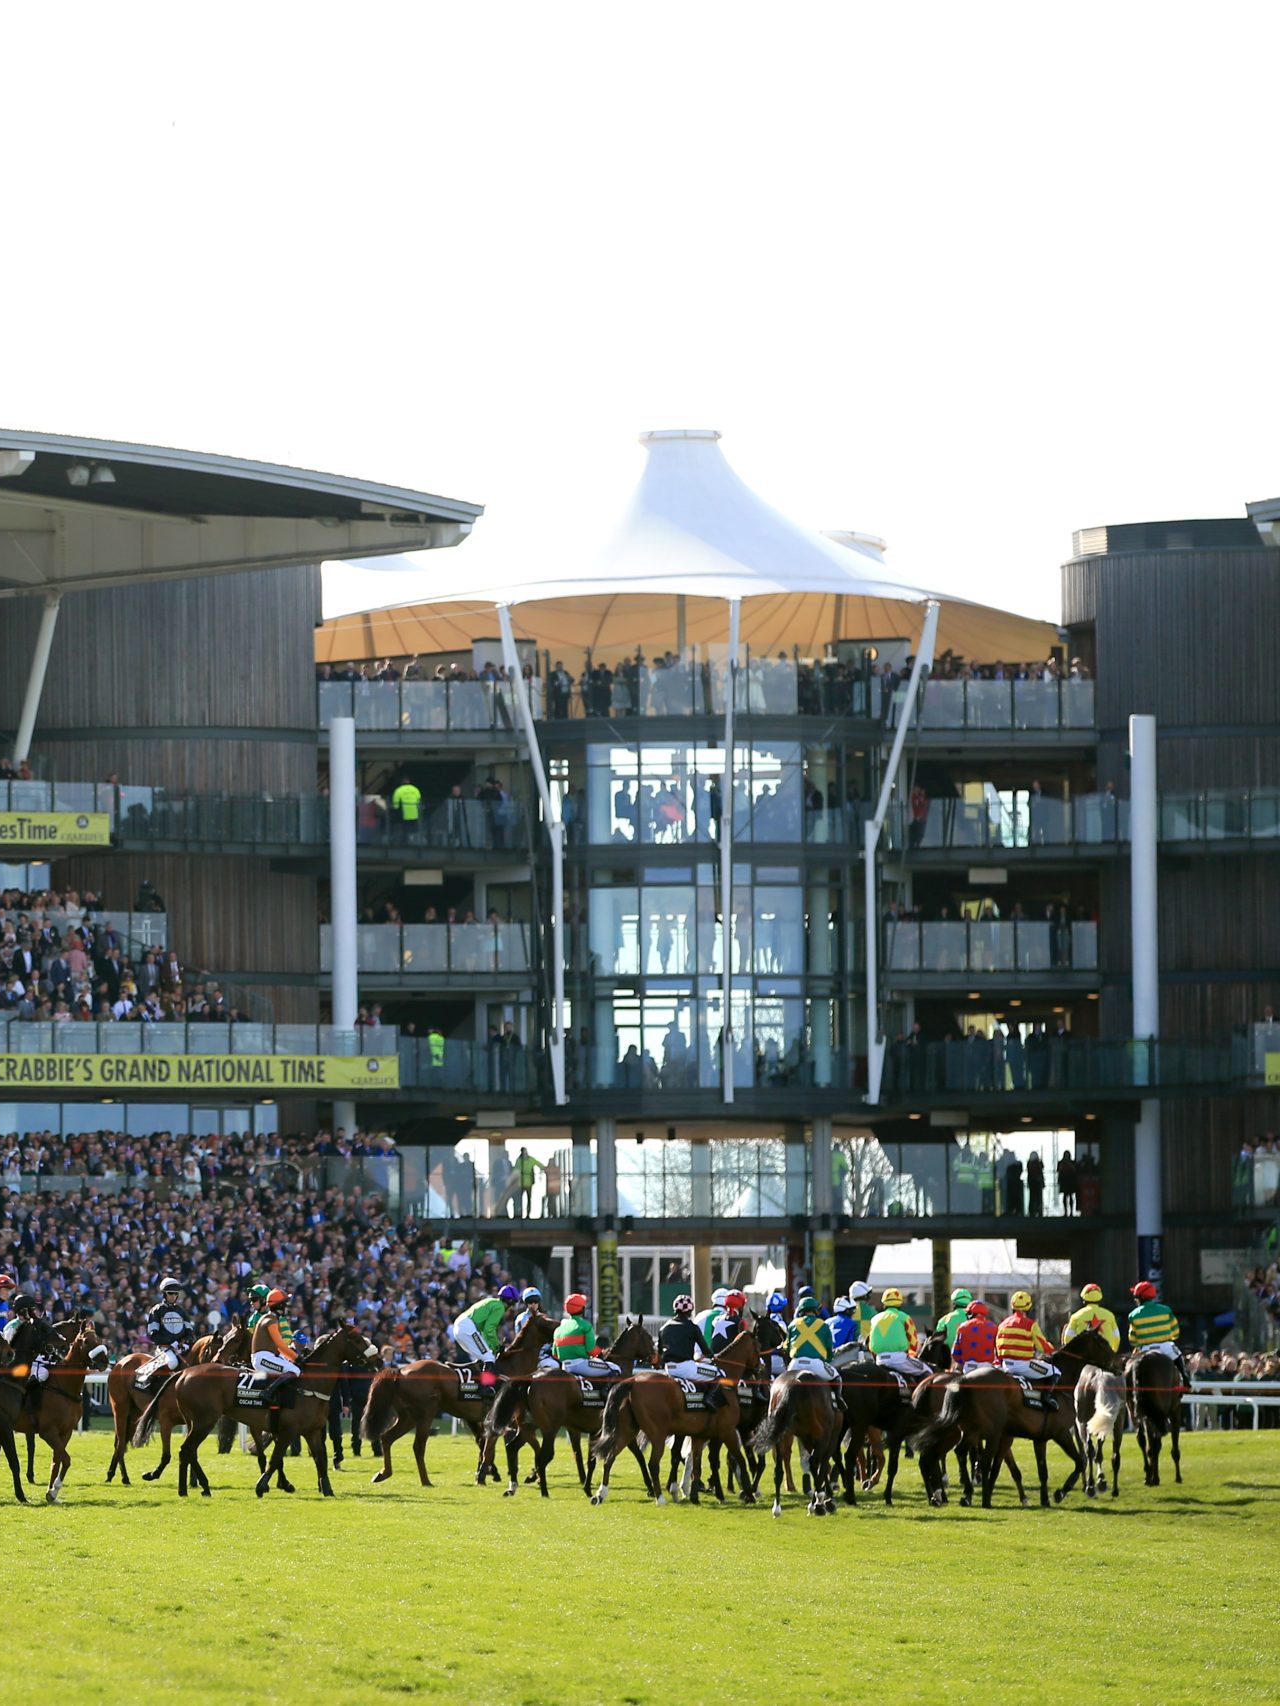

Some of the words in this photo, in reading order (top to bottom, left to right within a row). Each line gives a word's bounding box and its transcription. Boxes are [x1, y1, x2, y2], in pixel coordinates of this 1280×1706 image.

[100, 1059, 170, 1082] GRAND
[177, 1059, 274, 1083] NATIONAL
[280, 1060, 326, 1083] TIME
[237, 1372, 256, 1389] 27
[455, 1368, 475, 1384] 12
[675, 1377, 697, 1393] 36
